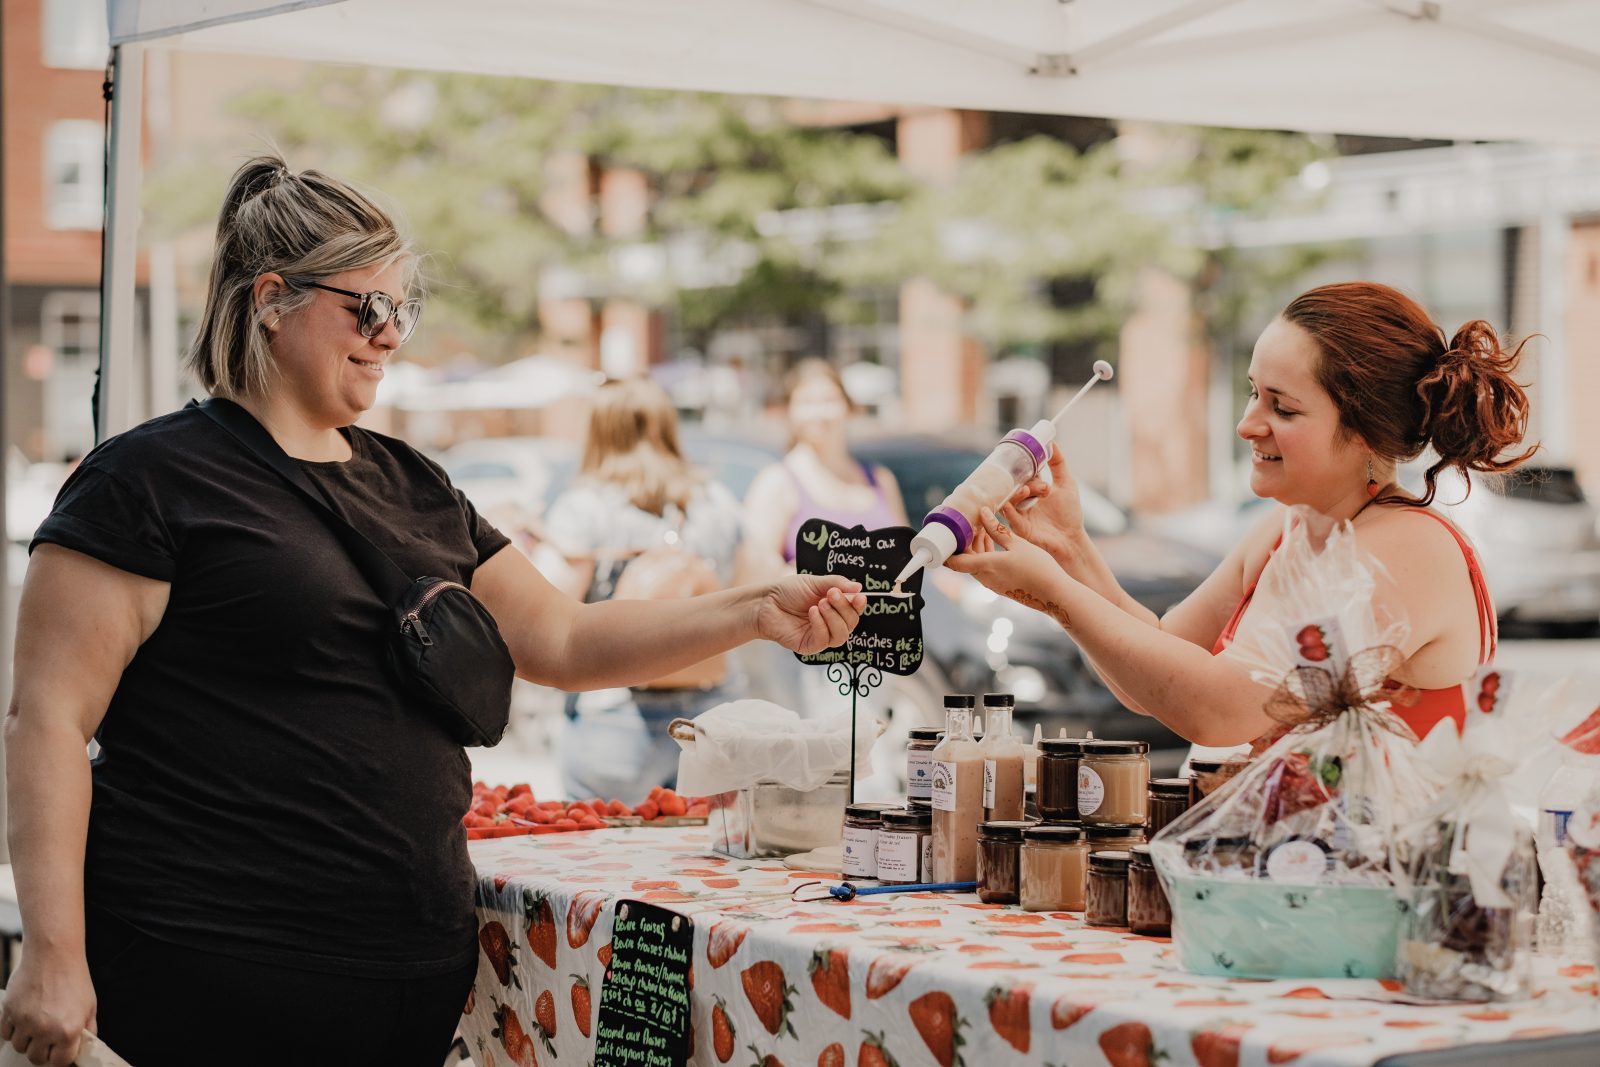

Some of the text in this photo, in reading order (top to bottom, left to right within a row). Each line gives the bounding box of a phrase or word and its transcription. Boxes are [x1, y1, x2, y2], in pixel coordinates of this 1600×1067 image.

[828, 531, 896, 549] Caramel aux
[863, 591, 915, 620] ochon!
